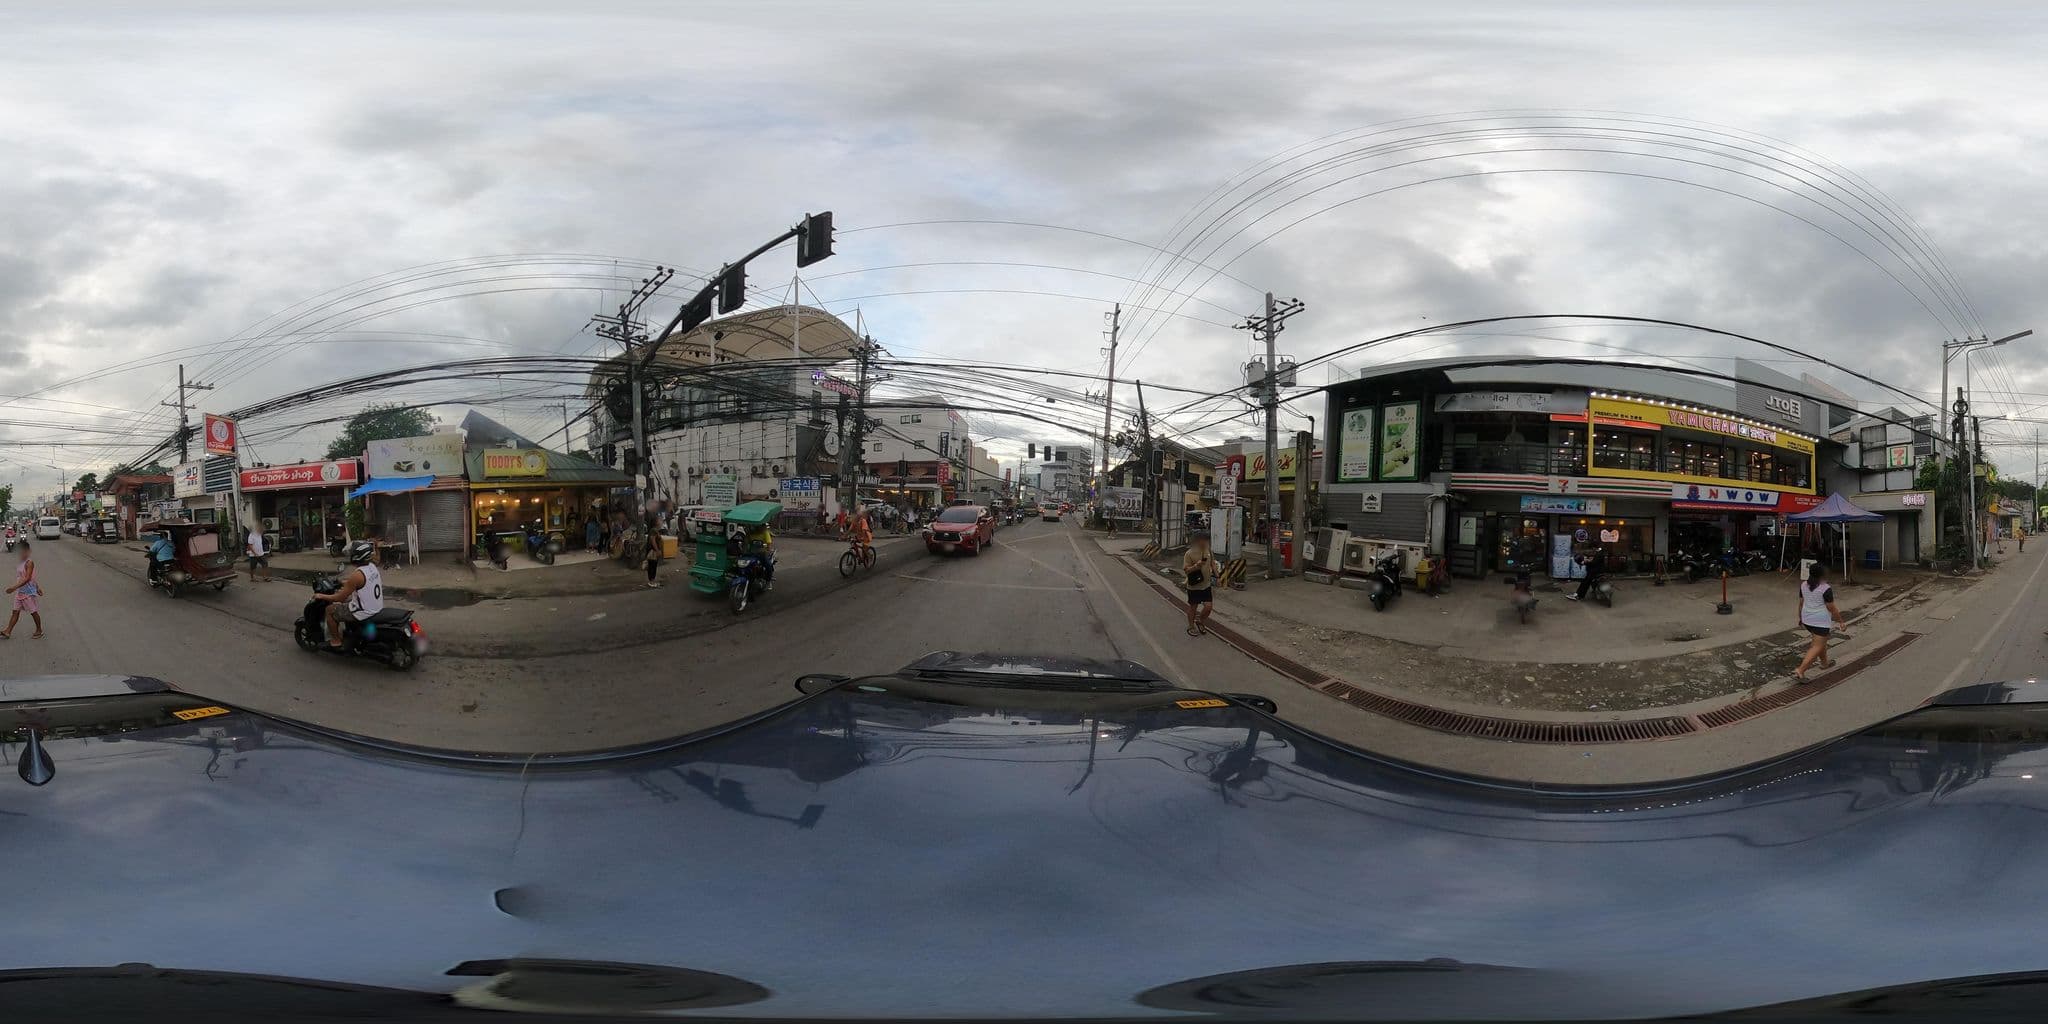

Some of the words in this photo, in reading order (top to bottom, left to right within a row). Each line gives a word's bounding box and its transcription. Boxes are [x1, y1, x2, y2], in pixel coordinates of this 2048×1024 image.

[1668, 409, 1738, 434] YAMICHAN
[486, 455, 523, 469] TODDY'S
[250, 474, 267, 484] the
[267, 471, 289, 485] pork
[291, 469, 314, 481] shop
[781, 479, 820, 490] 한국식품
